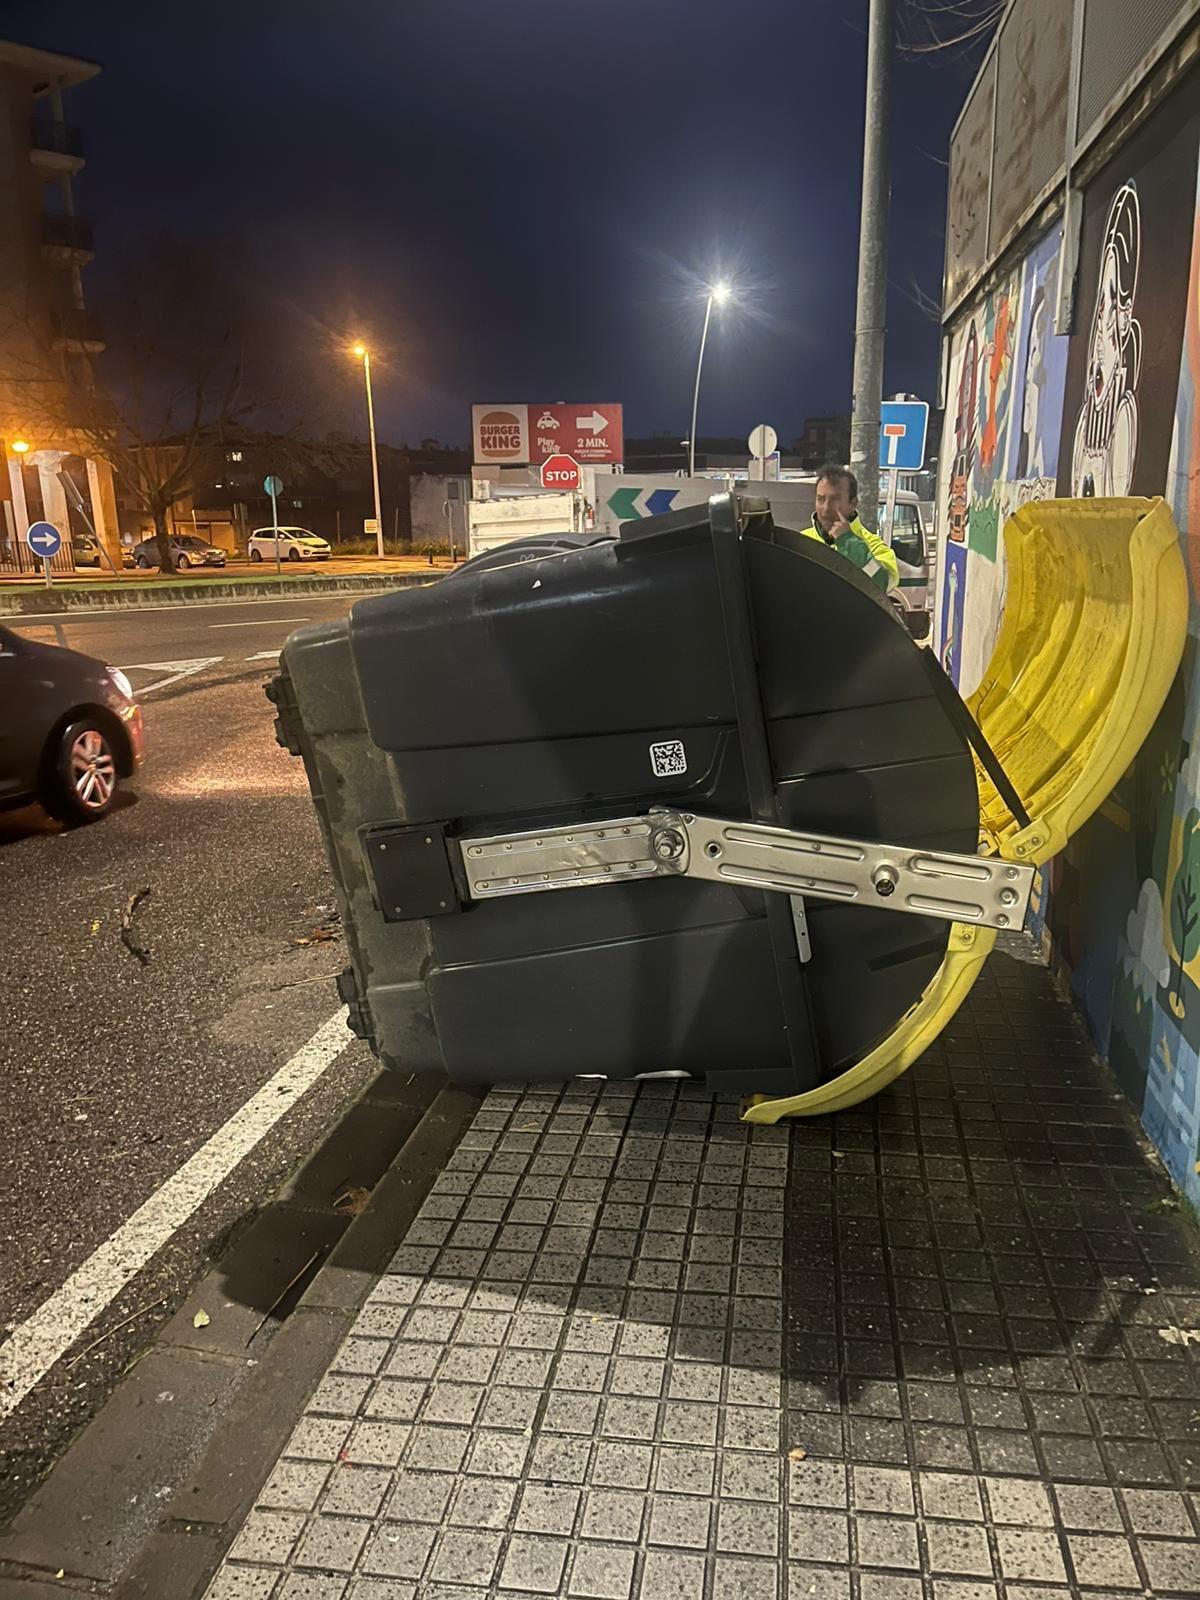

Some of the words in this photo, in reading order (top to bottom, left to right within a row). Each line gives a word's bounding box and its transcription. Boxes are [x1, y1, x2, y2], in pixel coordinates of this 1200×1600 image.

[480, 426, 520, 435] BURGER
[481, 436, 520, 449] KING
[537, 437, 555, 446] Play
[577, 438, 584, 448] 2
[585, 438, 608, 447] MIN.
[545, 471, 577, 481] STOP
